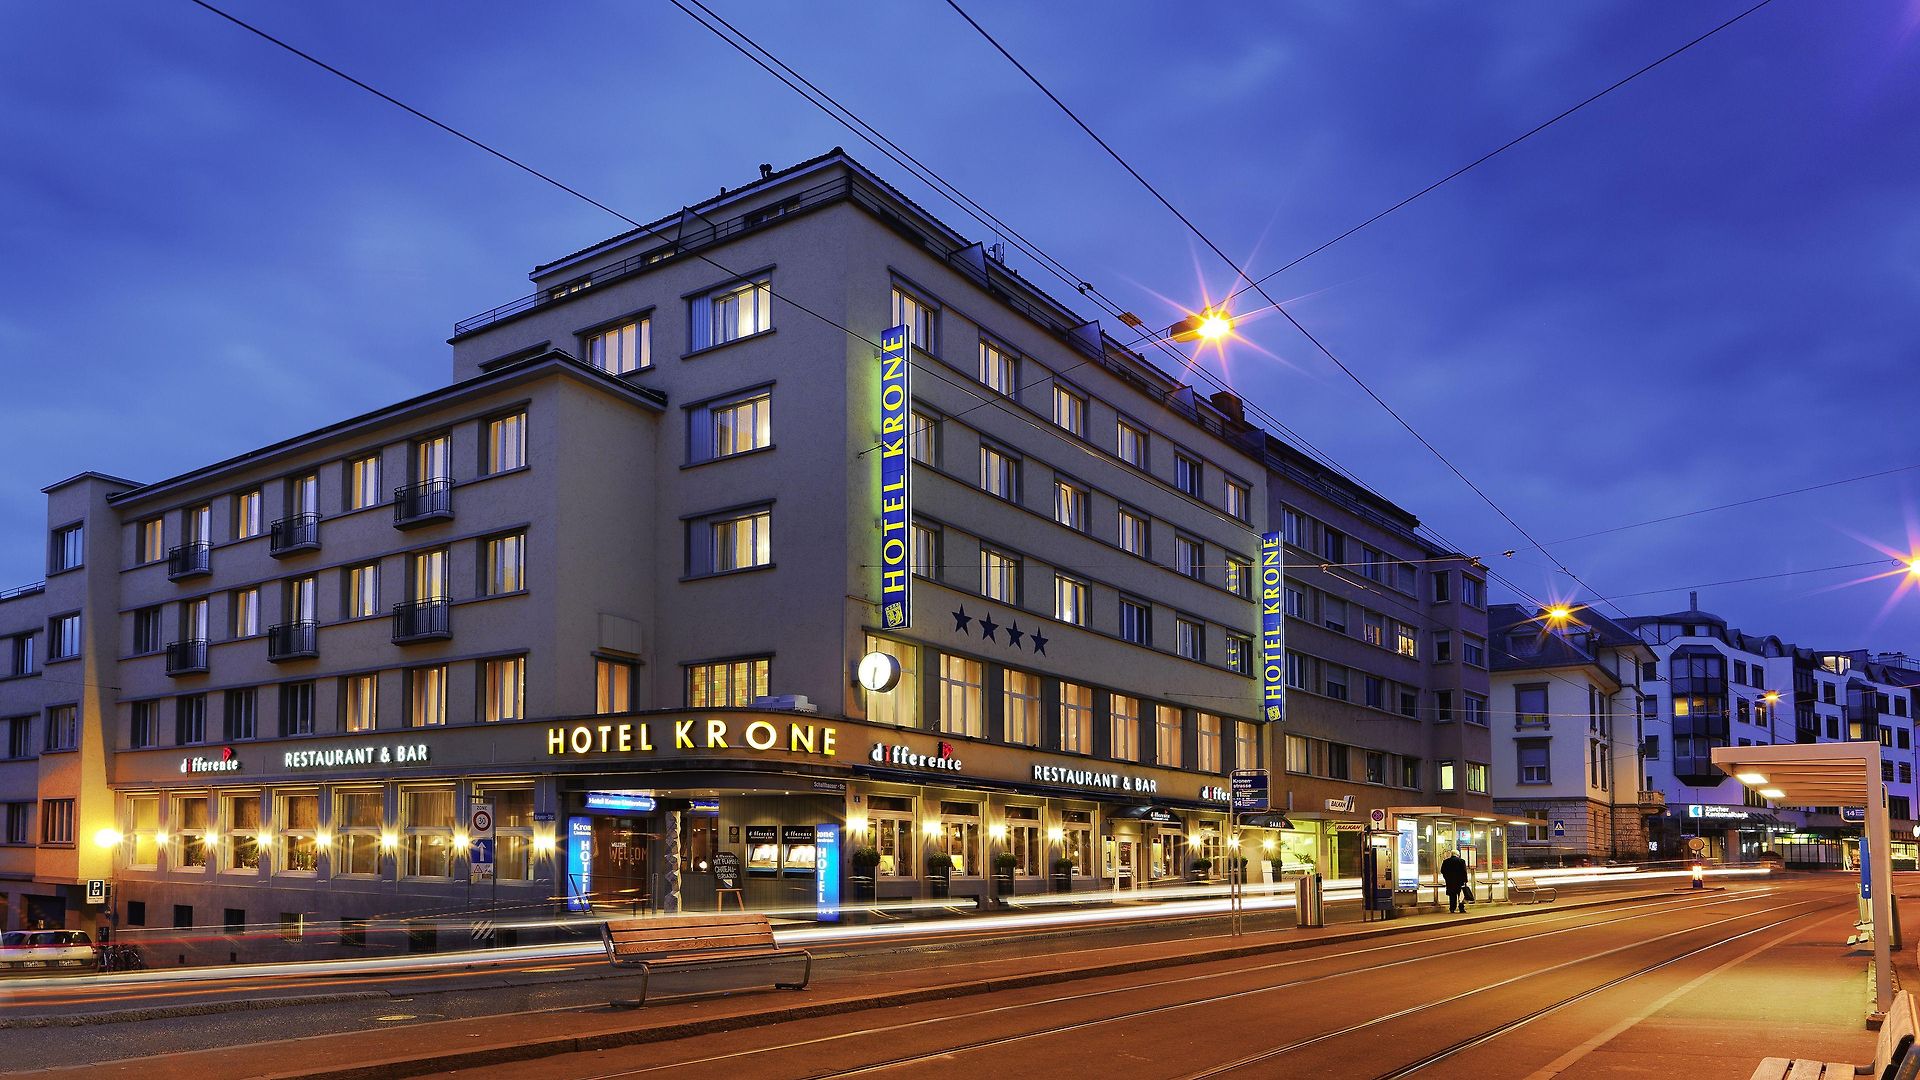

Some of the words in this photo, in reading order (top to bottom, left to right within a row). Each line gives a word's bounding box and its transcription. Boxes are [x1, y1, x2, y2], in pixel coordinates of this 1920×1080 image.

[882, 333, 905, 458] KRONE
[882, 474, 905, 593] HOTEL
[1263, 536, 1281, 615] KRONE
[1264, 625, 1282, 701] HOTEL
[547, 723, 653, 755] HOTEL
[675, 719, 837, 756] KRONE
[180, 757, 239, 774] differente
[284, 747, 375, 769] RESTAURANT
[380, 747, 391, 763] &
[397, 744, 428, 762] BAR
[872, 742, 962, 771] differente
[1034, 764, 1118, 788] RESTAURANT
[1122, 775, 1132, 789] &
[1135, 777, 1157, 793] BAR
[1705, 812, 1749, 820] Kantonalbank
[93, 882, 101, 890] P
[817, 847, 827, 903] HOTEL
